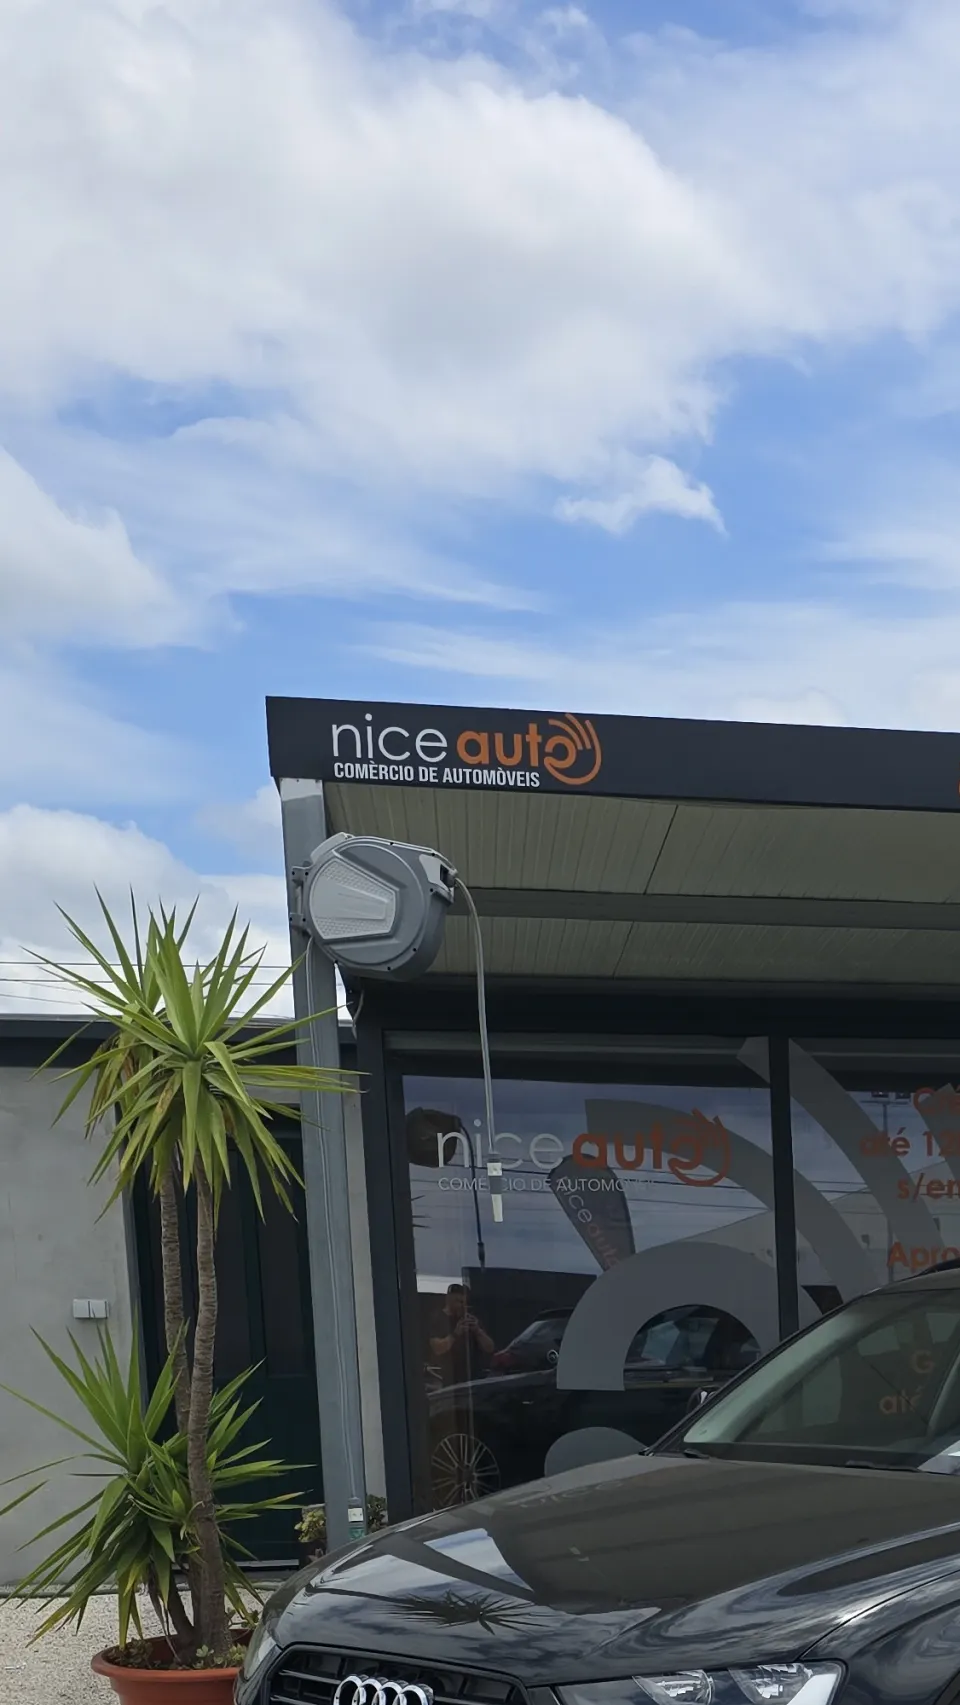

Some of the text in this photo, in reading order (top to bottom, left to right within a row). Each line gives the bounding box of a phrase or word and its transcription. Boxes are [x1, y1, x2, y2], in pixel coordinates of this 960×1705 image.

[418, 766, 439, 783] DE
[859, 1126, 911, 1158] até
[438, 1174, 524, 1191] COMÉCIO
